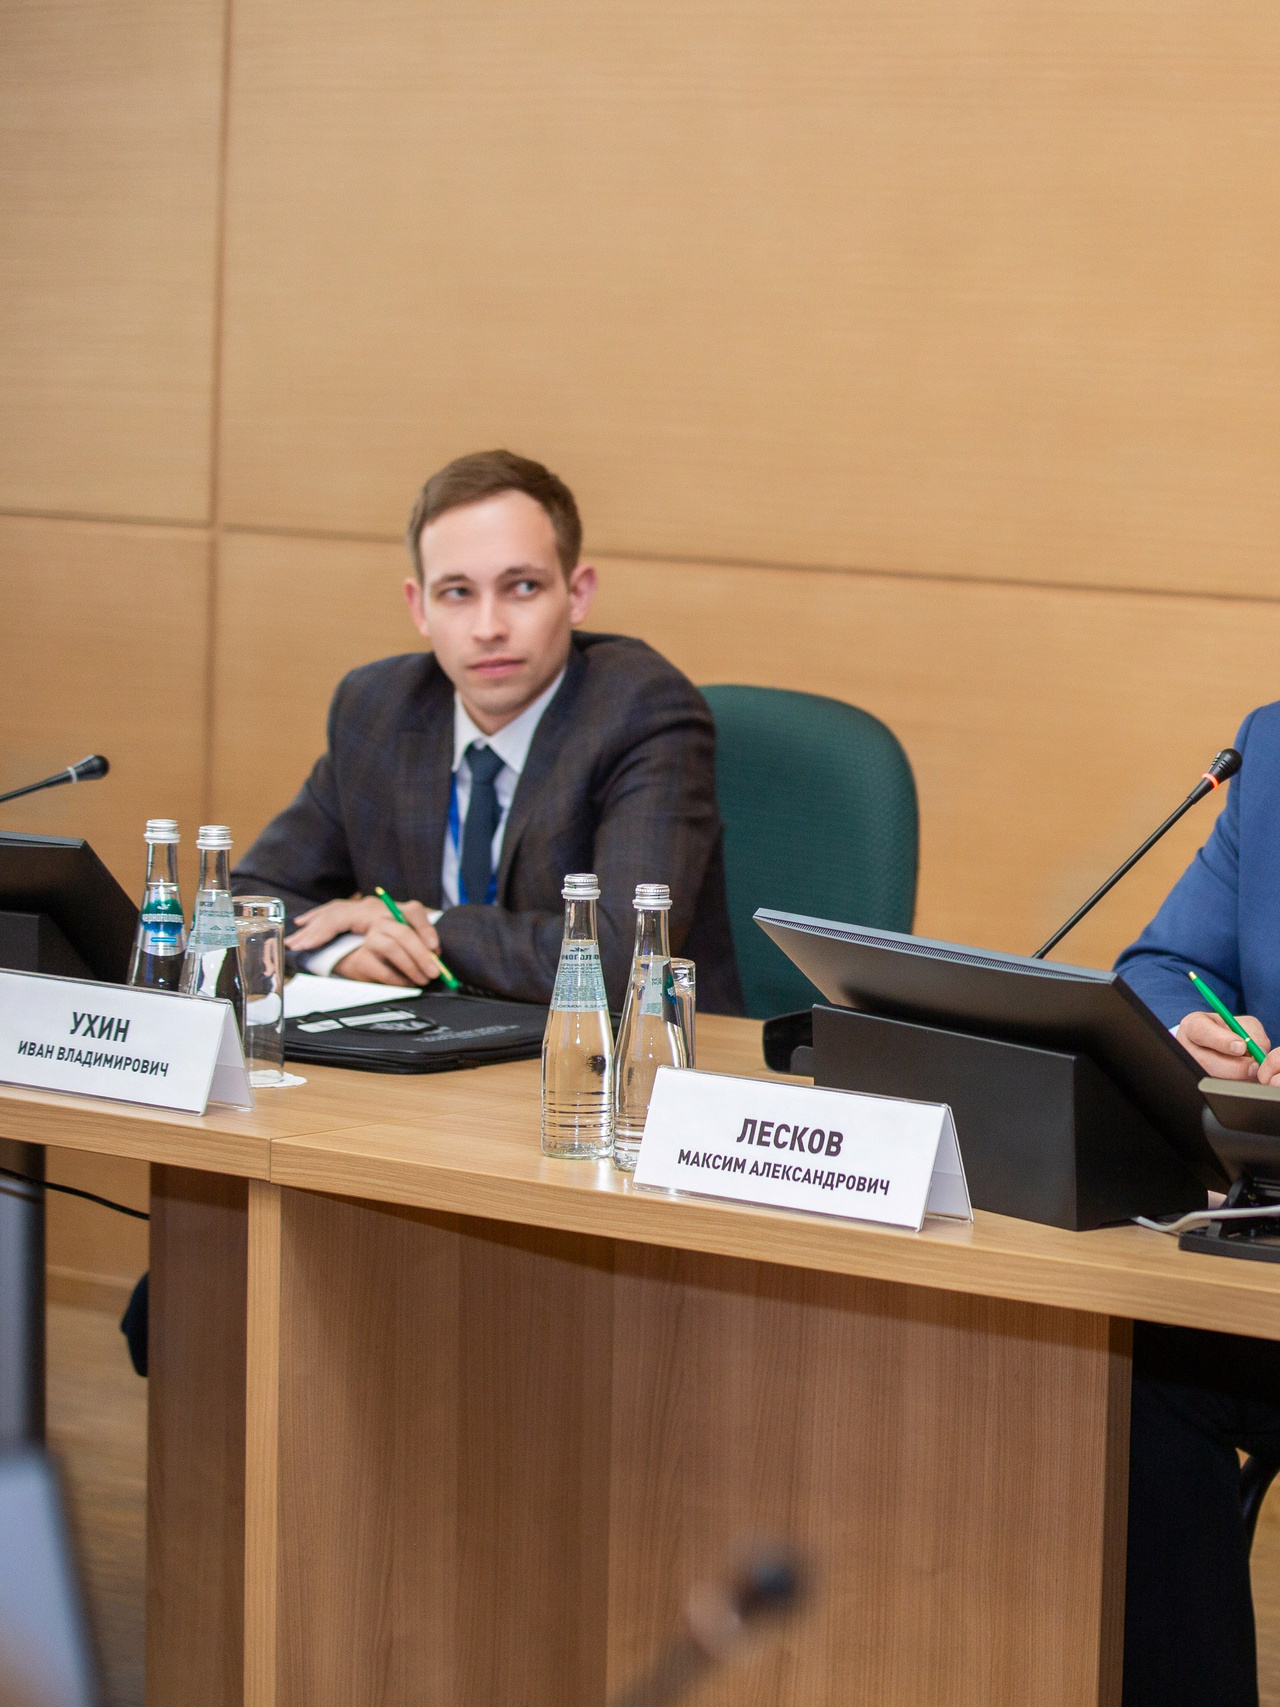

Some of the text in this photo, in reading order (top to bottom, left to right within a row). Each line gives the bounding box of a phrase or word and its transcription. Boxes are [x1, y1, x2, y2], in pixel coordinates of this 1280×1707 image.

[69, 1011, 131, 1043] УХИН
[17, 1040, 170, 1077] ИВАН ВЛАДИМИРОВИЧ
[736, 1117, 845, 1158] ЛЕСКОВ
[677, 1149, 891, 1196] МАКСИМ АЛЕКСАНДРОВИЧ
